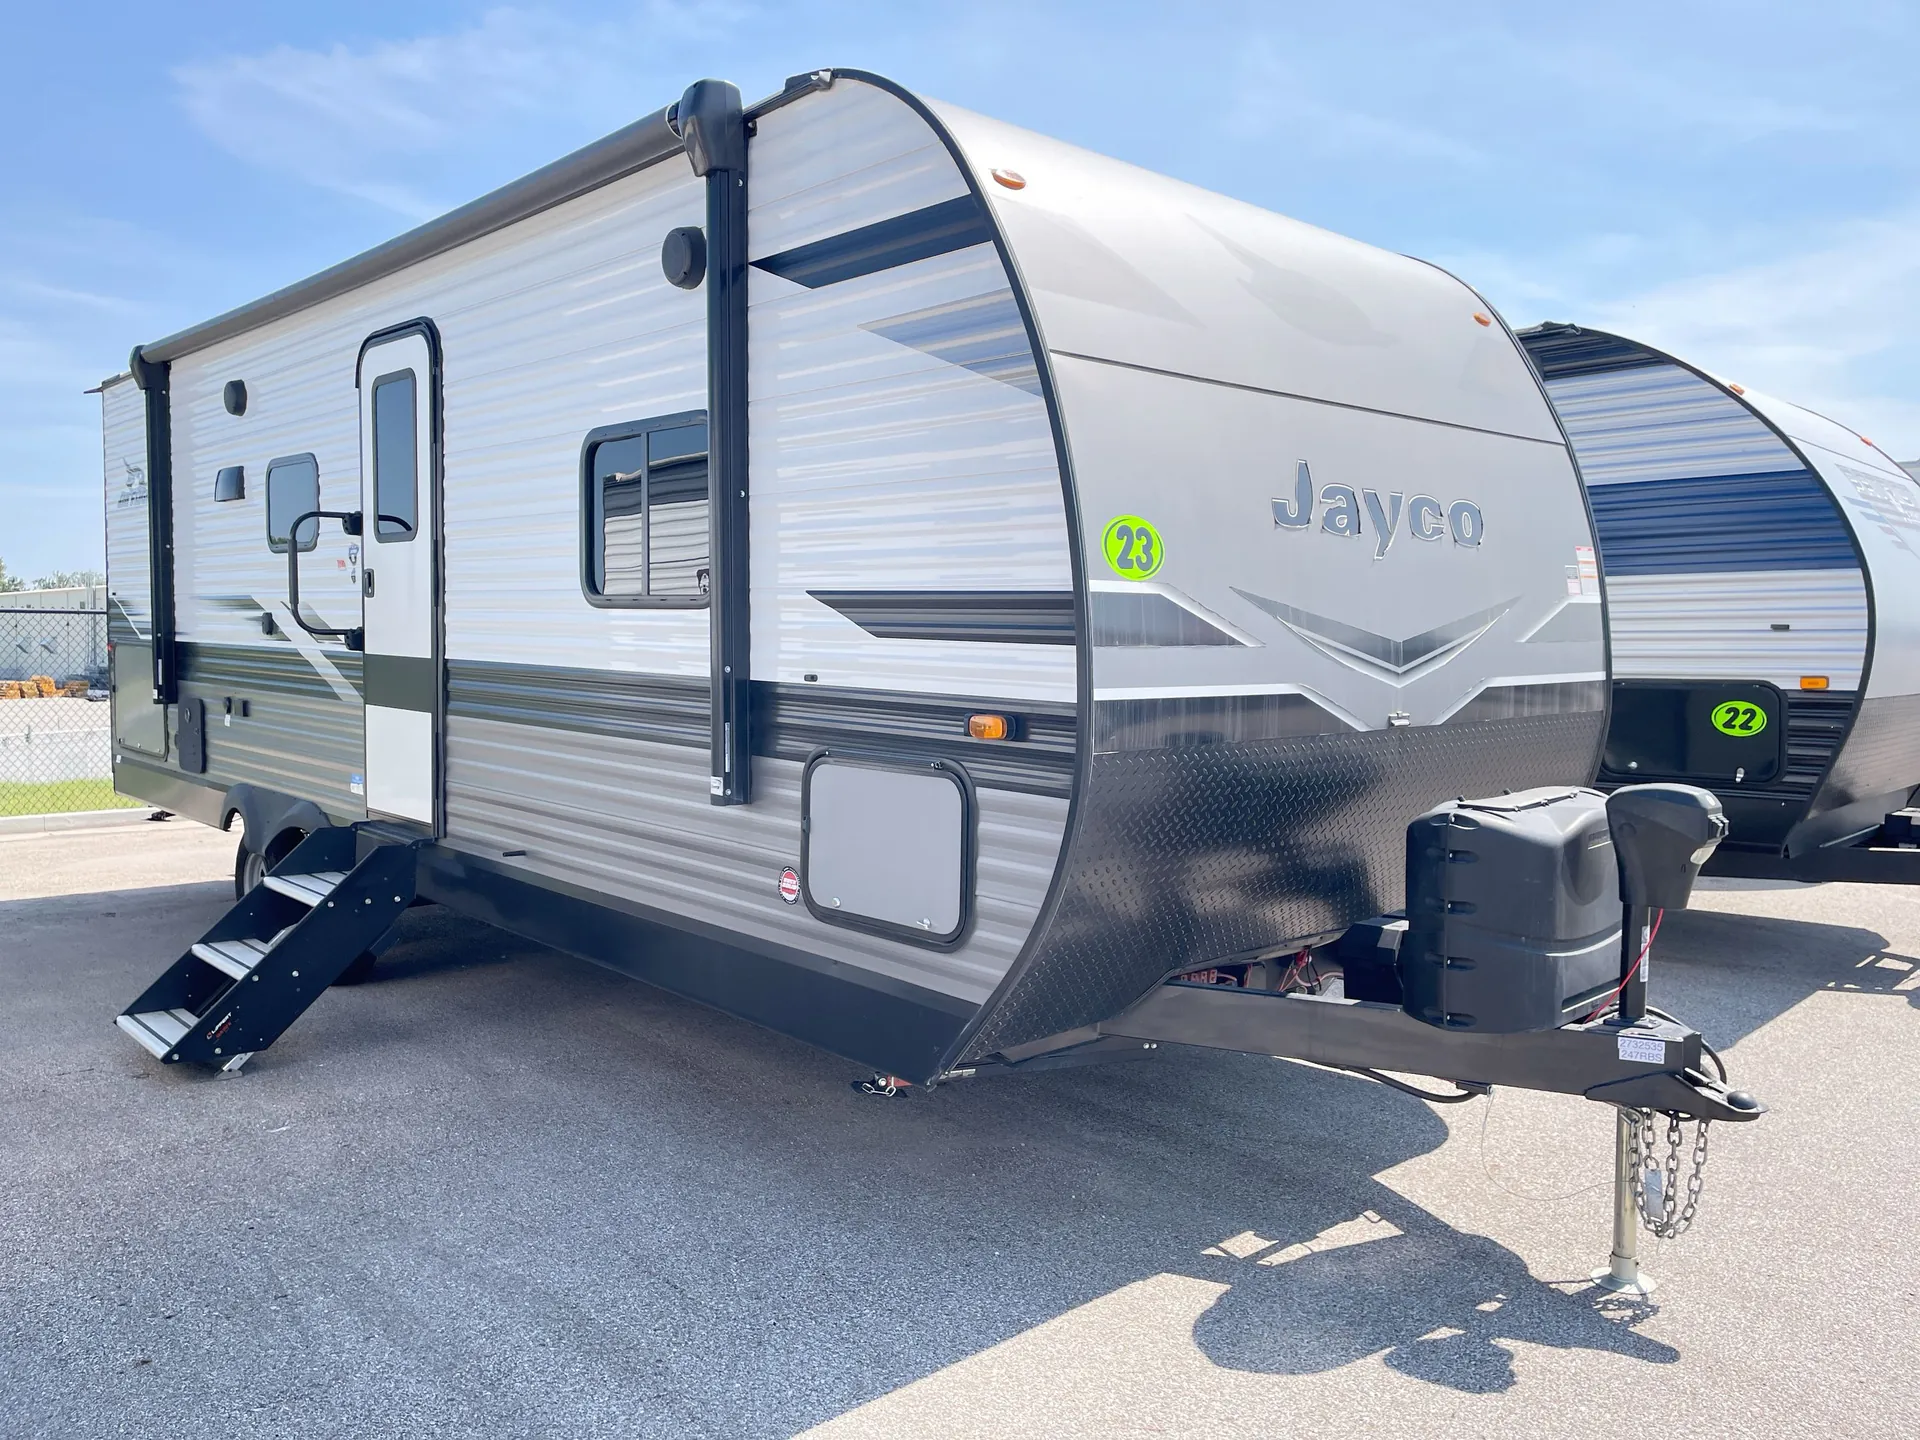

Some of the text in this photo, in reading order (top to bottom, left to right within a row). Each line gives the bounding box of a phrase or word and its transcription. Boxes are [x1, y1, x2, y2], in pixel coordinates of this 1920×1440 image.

[1271, 458, 1484, 560] Jayco
[1116, 524, 1154, 572] 23
[1722, 706, 1757, 731] 22
[1620, 1039, 1664, 1052] 2732535
[1621, 1049, 1663, 1062] 247RBS
